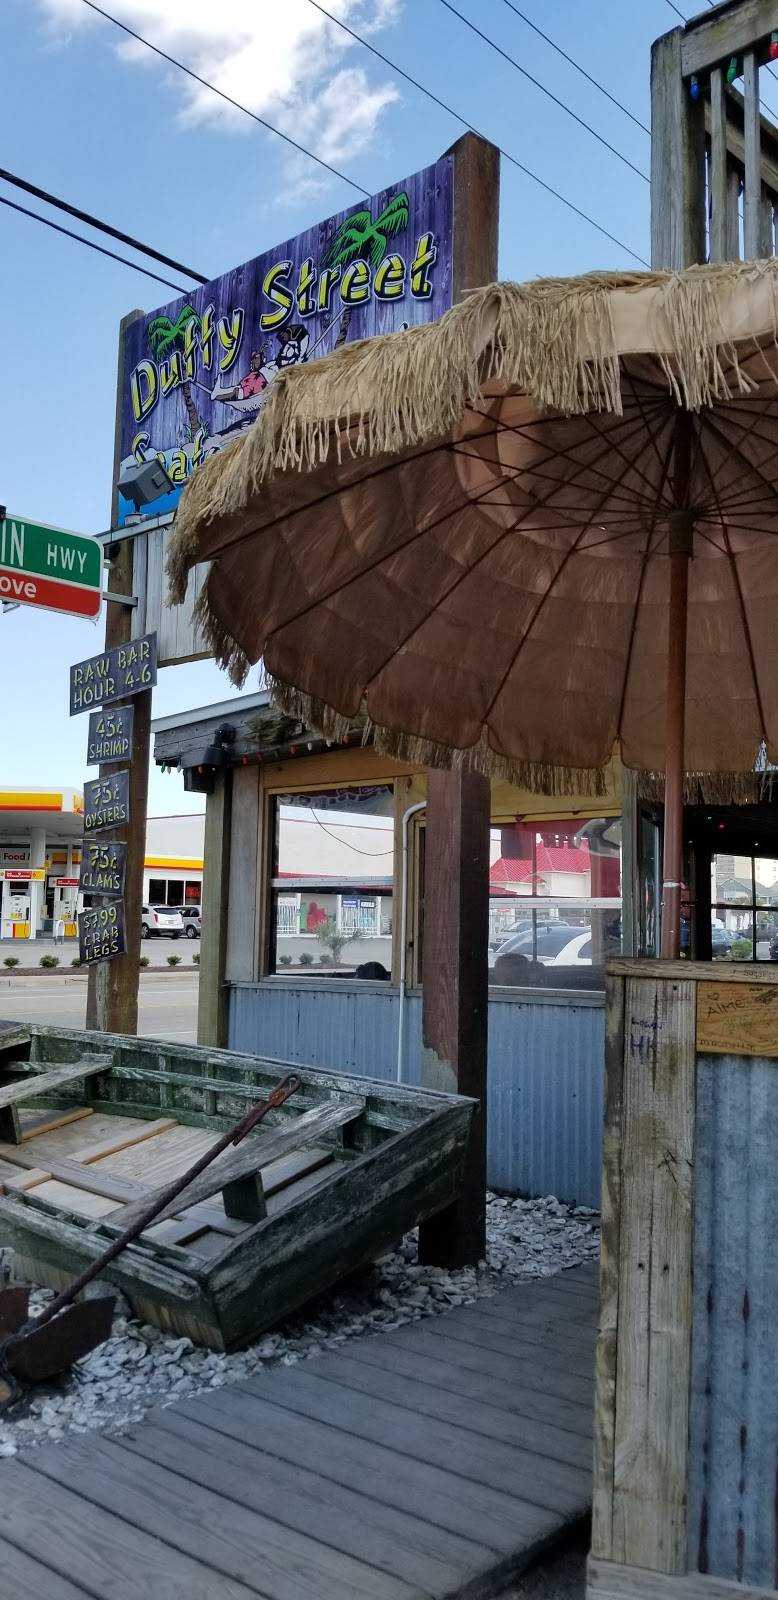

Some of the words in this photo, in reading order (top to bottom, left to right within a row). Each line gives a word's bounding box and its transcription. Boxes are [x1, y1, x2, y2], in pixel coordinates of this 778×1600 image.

[130, 304, 244, 423] Duffy
[259, 231, 437, 332] Street
[47, 543, 87, 574] HWY
[73, 657, 110, 686] RAW
[118, 641, 150, 669] BAR
[74, 677, 115, 708] HOUR
[125, 663, 152, 687] 4-6
[89, 738, 129, 759] SHRIMP
[85, 804, 126, 828] OYSTERS
[3, 852, 26, 861] Food
[82, 872, 120, 889] CLAMS
[84, 926, 119, 946] CRAB
[85, 940, 119, 960] LEGS
